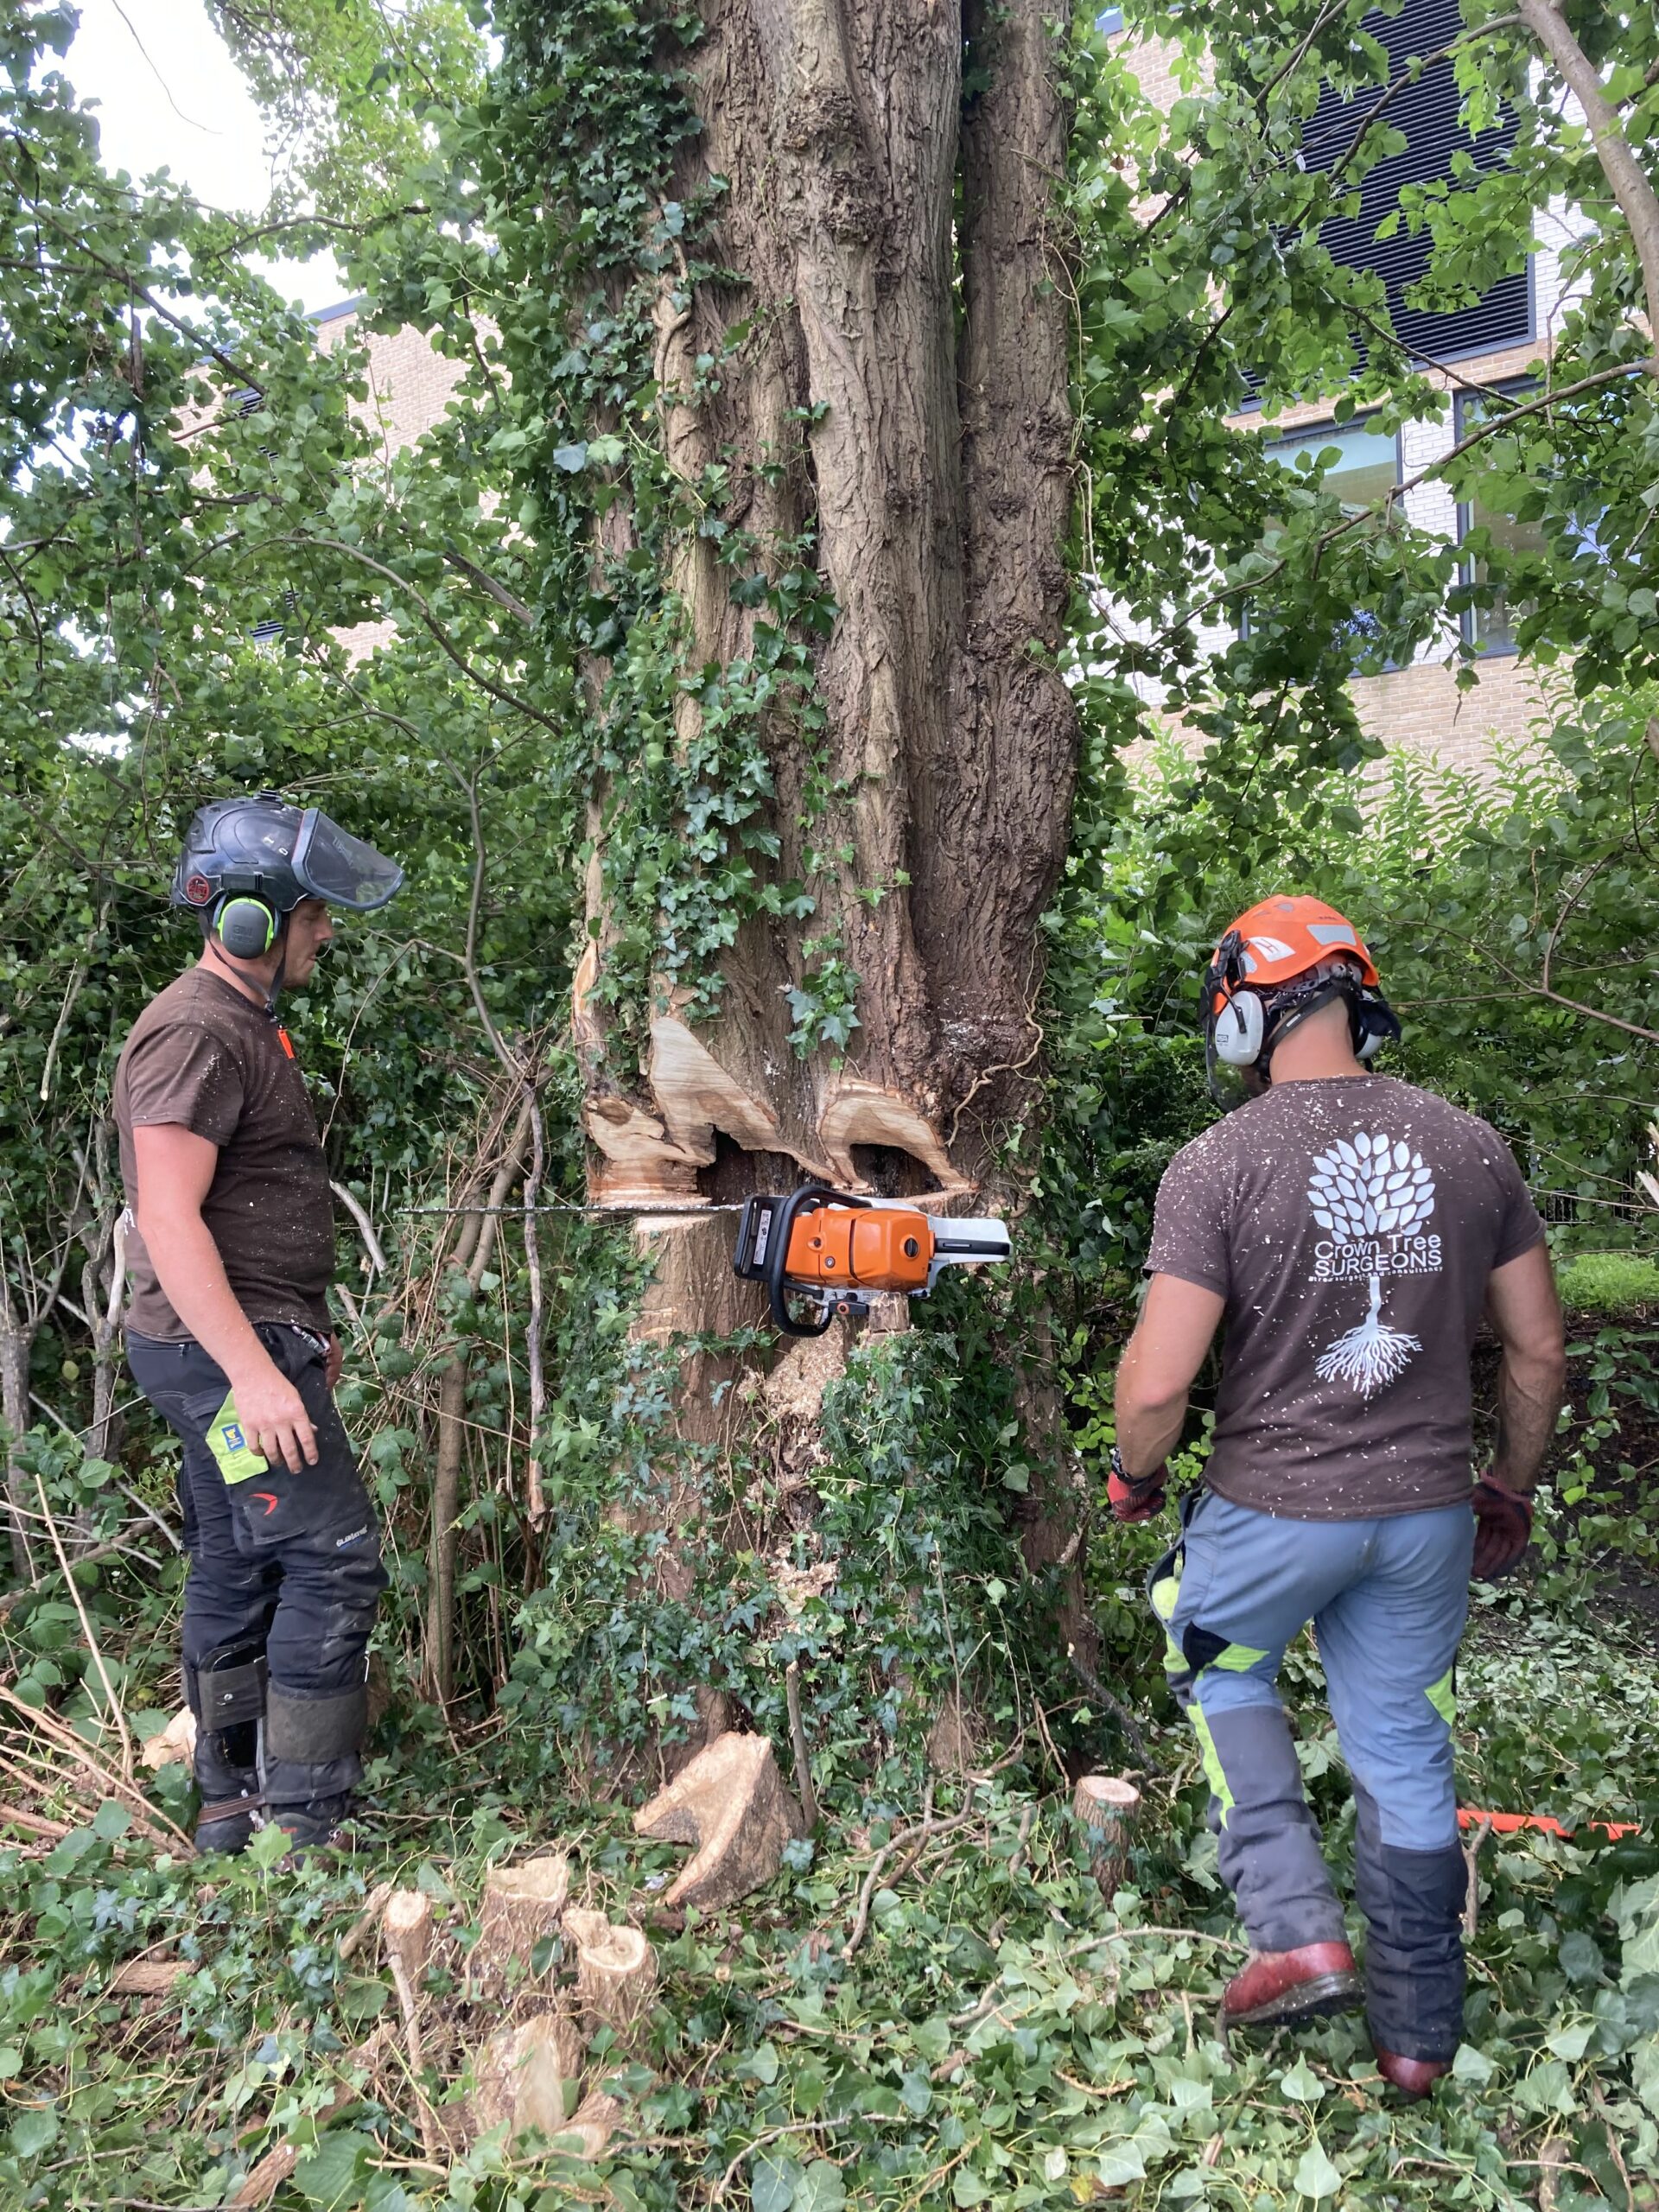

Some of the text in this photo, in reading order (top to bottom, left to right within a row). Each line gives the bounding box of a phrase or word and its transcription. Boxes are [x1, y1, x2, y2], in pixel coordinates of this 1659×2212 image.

[1314, 1234, 1441, 1259] Crown Tree
[1314, 1249, 1442, 1276] SURGEONS
[1387, 1266, 1443, 1275] consultancy
